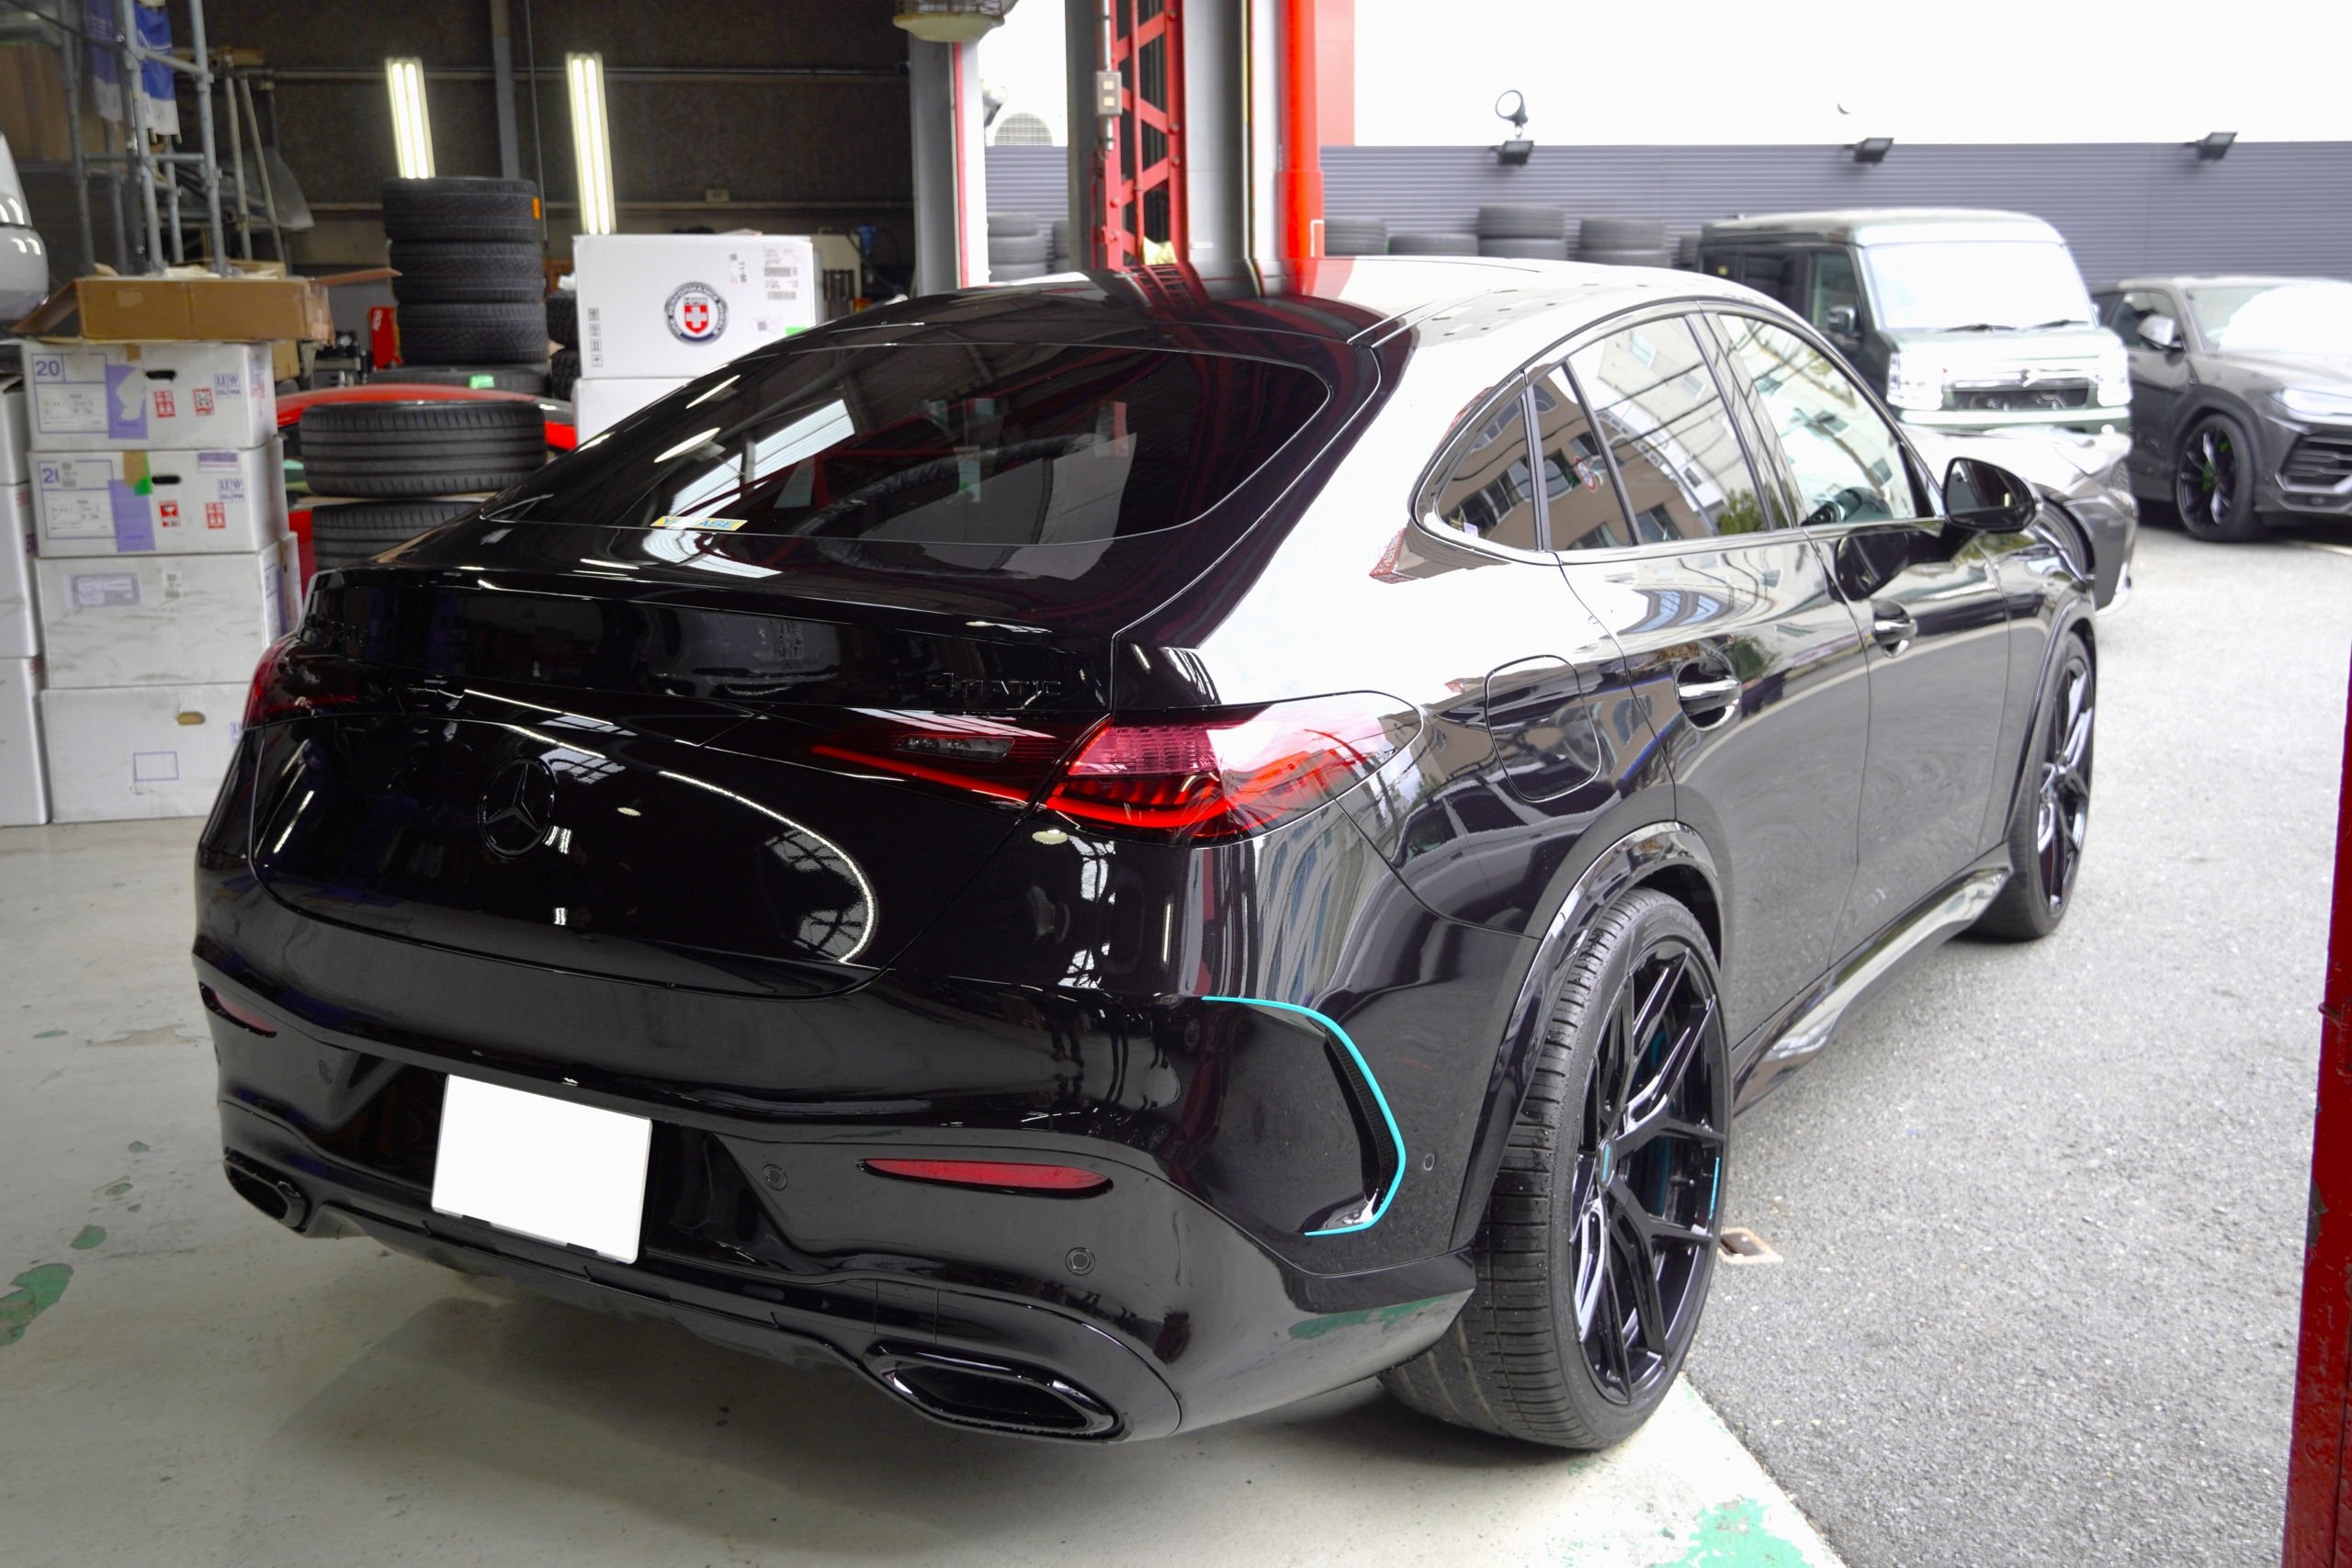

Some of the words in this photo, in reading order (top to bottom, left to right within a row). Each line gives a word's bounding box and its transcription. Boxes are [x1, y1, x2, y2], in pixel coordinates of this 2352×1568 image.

[35, 360, 61, 378] 20
[42, 468, 61, 484] 2
[663, 517, 739, 528] YAASE
[924, 671, 1061, 697] 4MATIC
